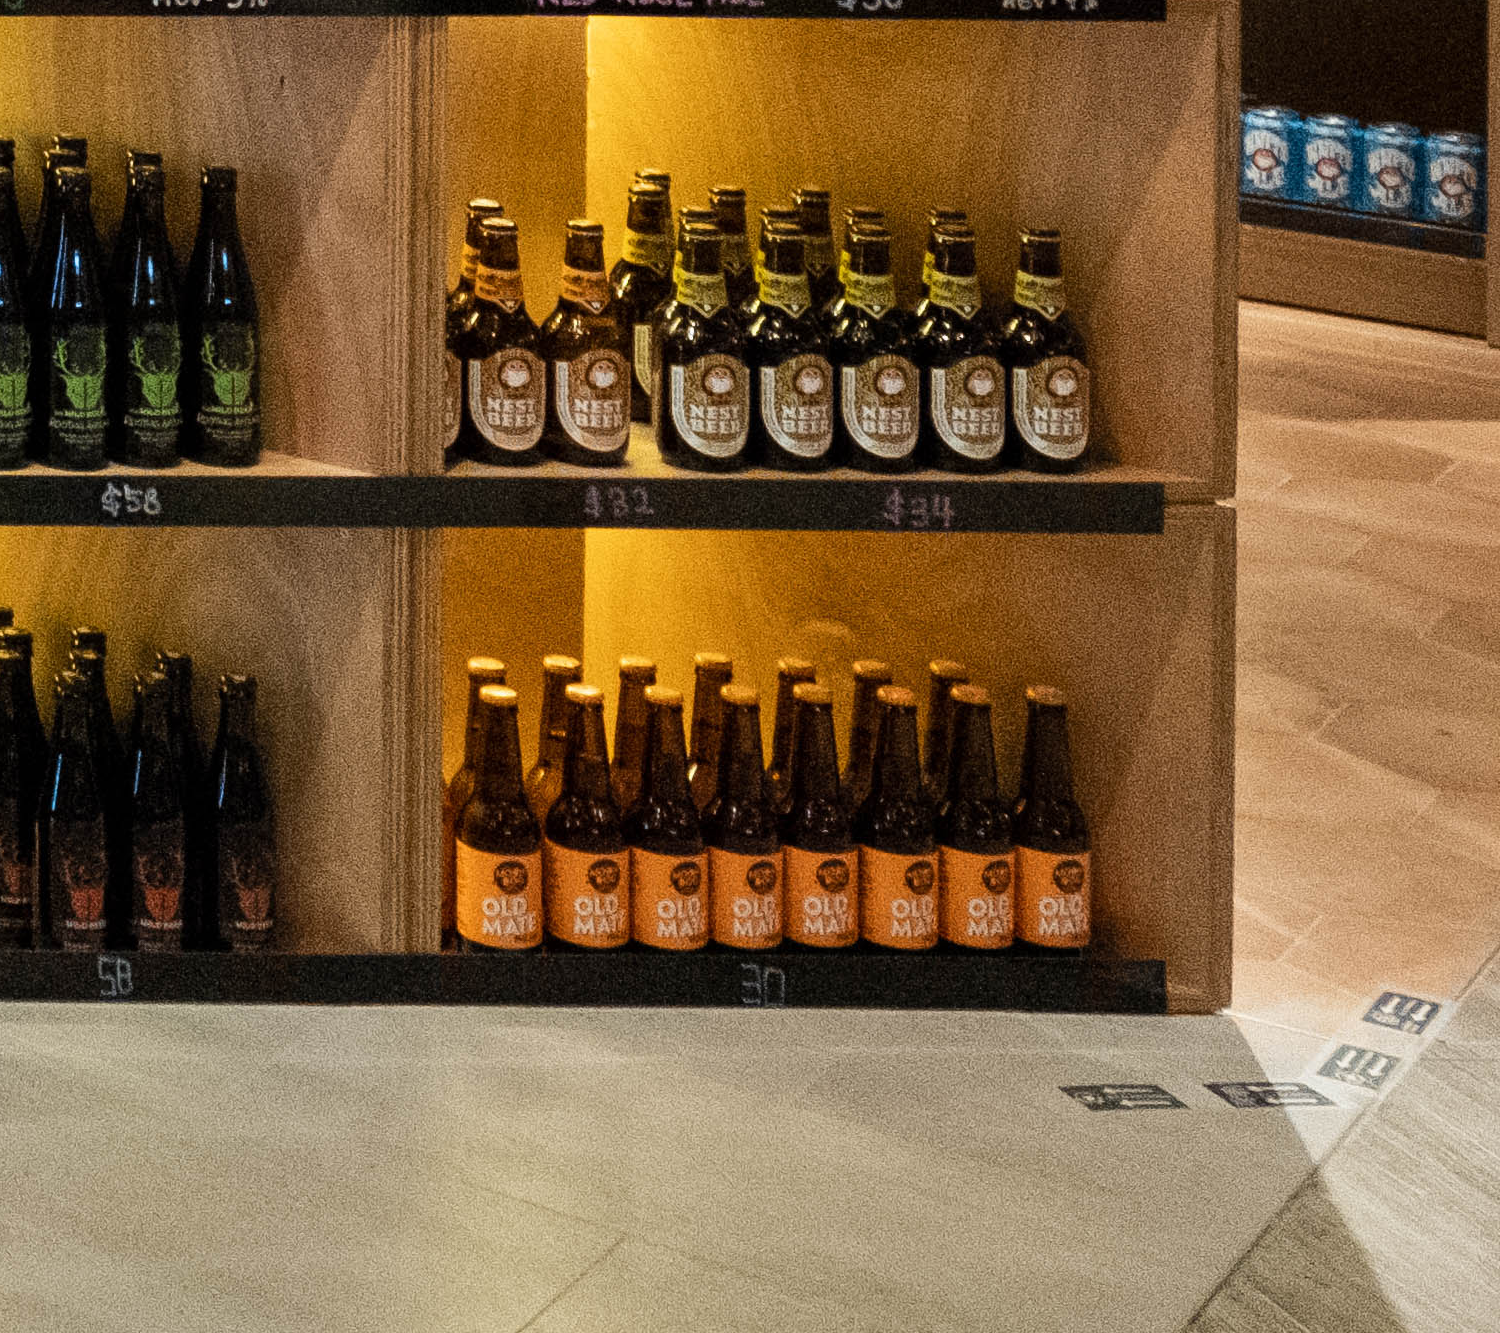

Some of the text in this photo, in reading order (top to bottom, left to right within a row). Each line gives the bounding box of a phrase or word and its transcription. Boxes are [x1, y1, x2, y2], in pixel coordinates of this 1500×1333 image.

[690, 405, 740, 419] NEST
[952, 407, 999, 420] NEST
[1033, 407, 1081, 421] NEST
[690, 419, 740, 434] BEER
[102, 482, 160, 518] $58
[482, 897, 528, 917] OLD
[574, 896, 619, 916] OLD
[804, 897, 848, 917] OLD
[1038, 897, 1082, 917] OLD
[741, 963, 785, 1006] 30
